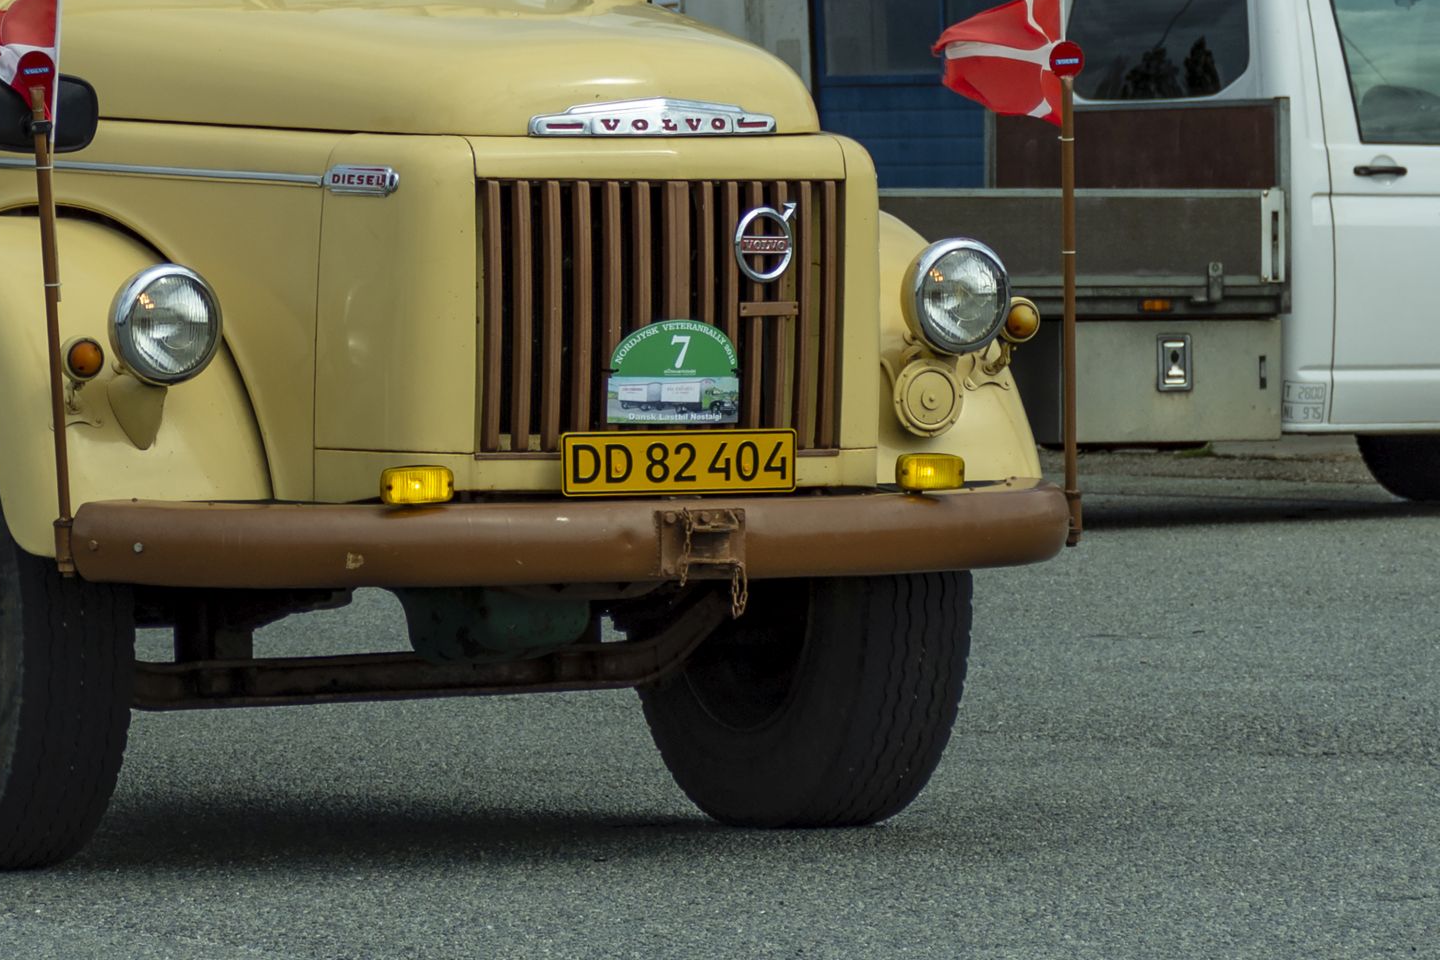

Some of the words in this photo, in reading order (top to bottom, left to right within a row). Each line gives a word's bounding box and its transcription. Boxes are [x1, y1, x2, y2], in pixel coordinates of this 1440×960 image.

[24, 66, 50, 75] VOLVO
[600, 117, 727, 132] VOLVO
[331, 173, 385, 188] DIESEL
[743, 239, 787, 251] VOLVO
[614, 325, 660, 366] NORDJYSK
[662, 322, 728, 347] VETERANRALLY
[671, 334, 692, 369] 7
[1286, 384, 1292, 399] T
[1298, 385, 1324, 401] 2800
[628, 412, 658, 421] Dansk
[690, 411, 723, 422] Nostalgi
[571, 443, 634, 484] DD
[645, 442, 697, 483] 82
[707, 440, 788, 482] 404
